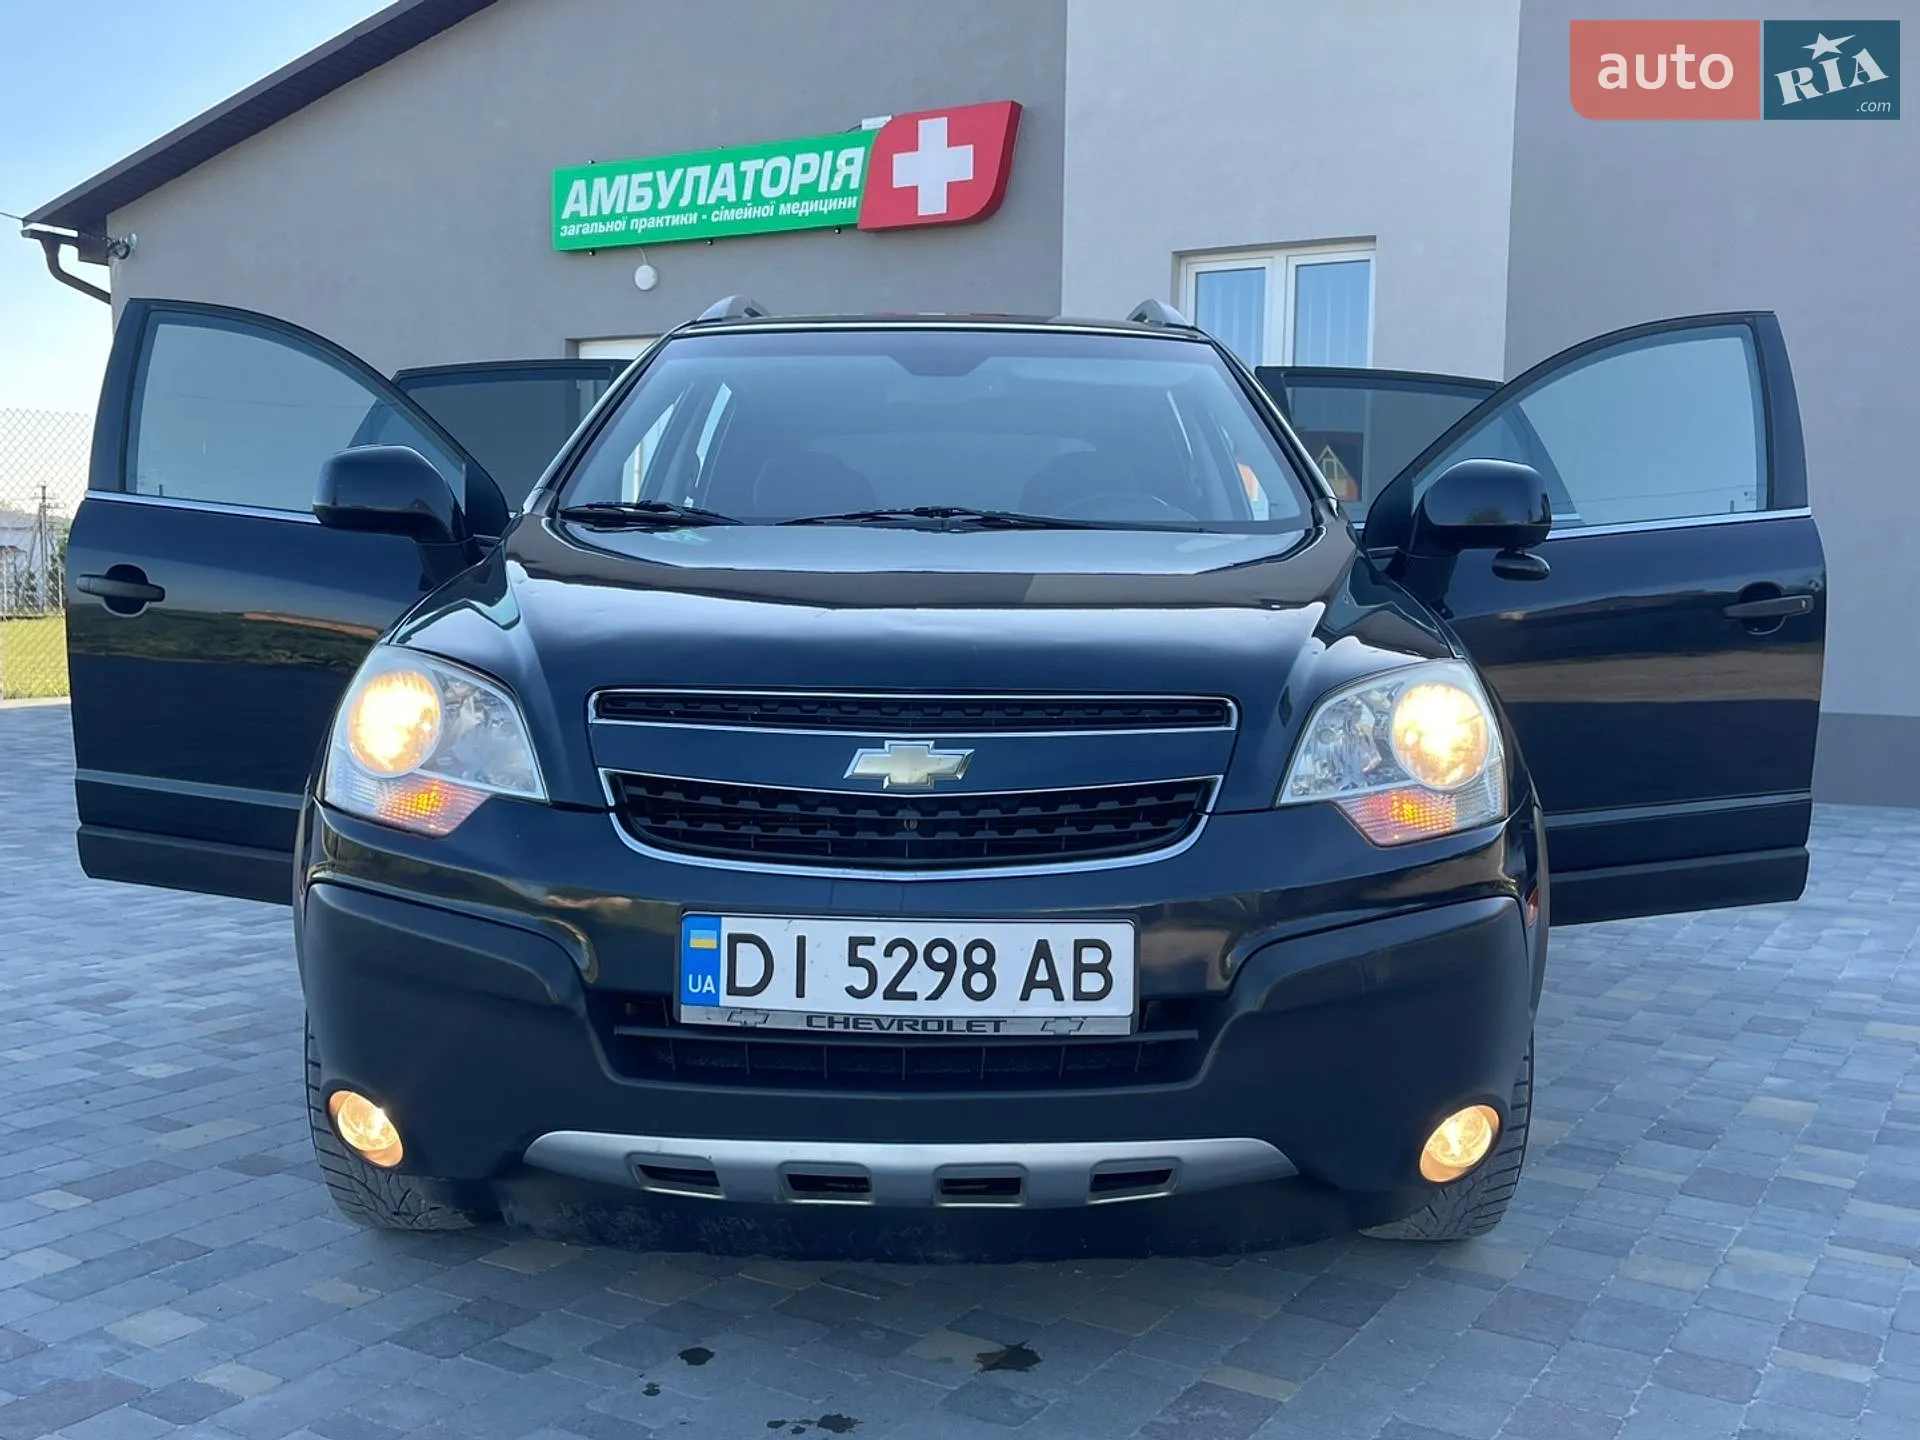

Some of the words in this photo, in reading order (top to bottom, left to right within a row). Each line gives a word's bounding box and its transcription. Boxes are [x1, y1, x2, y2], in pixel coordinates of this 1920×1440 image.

[561, 146, 865, 219] АМБУЛАТОРІЯ
[560, 216, 627, 237] загальної
[629, 211, 698, 234] практики
[711, 201, 775, 223] сімейної
[779, 196, 858, 216] медицини
[688, 974, 716, 994] UA
[726, 933, 807, 998] DI
[844, 936, 997, 1002] 5298
[1019, 938, 1113, 1001] AB
[805, 1014, 1007, 1034] CHEVROLET
